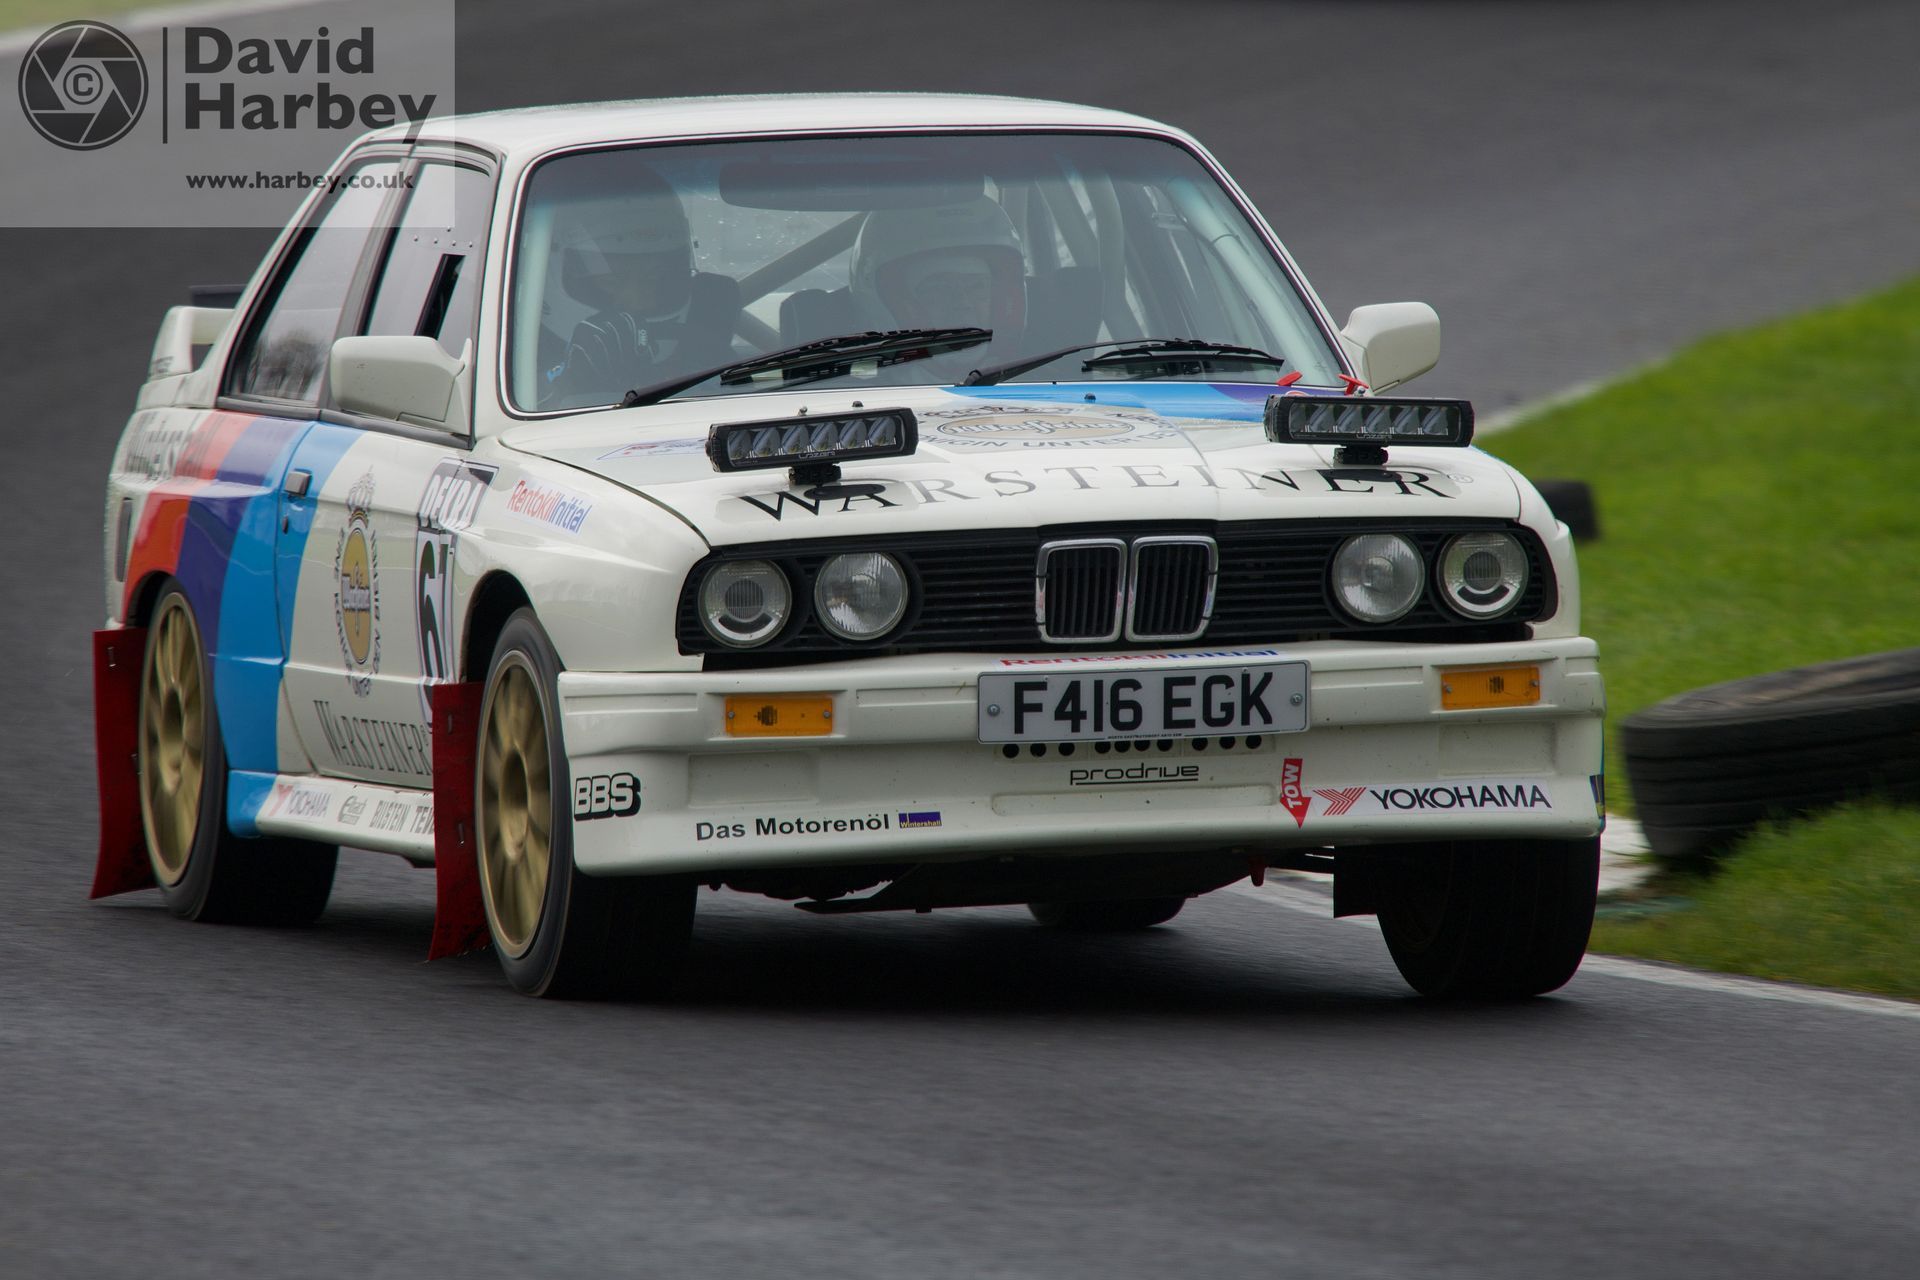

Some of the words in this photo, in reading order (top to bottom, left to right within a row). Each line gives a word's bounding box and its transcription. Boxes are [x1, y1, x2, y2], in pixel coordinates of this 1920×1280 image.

[419, 475, 487, 529] DEKRA
[738, 464, 1456, 521] WARSTEINER
[1014, 678, 1144, 734] F416
[1163, 672, 1274, 730] EGK
[313, 700, 432, 776] WARSTEINER
[574, 772, 642, 821] BBS
[1070, 763, 1200, 786] prodrive
[1282, 763, 1300, 808] TOW
[1370, 785, 1552, 810] YOKOHAMA
[696, 820, 746, 841] Das
[755, 813, 890, 836] Motorenöl
[900, 820, 942, 829] Wintershall
